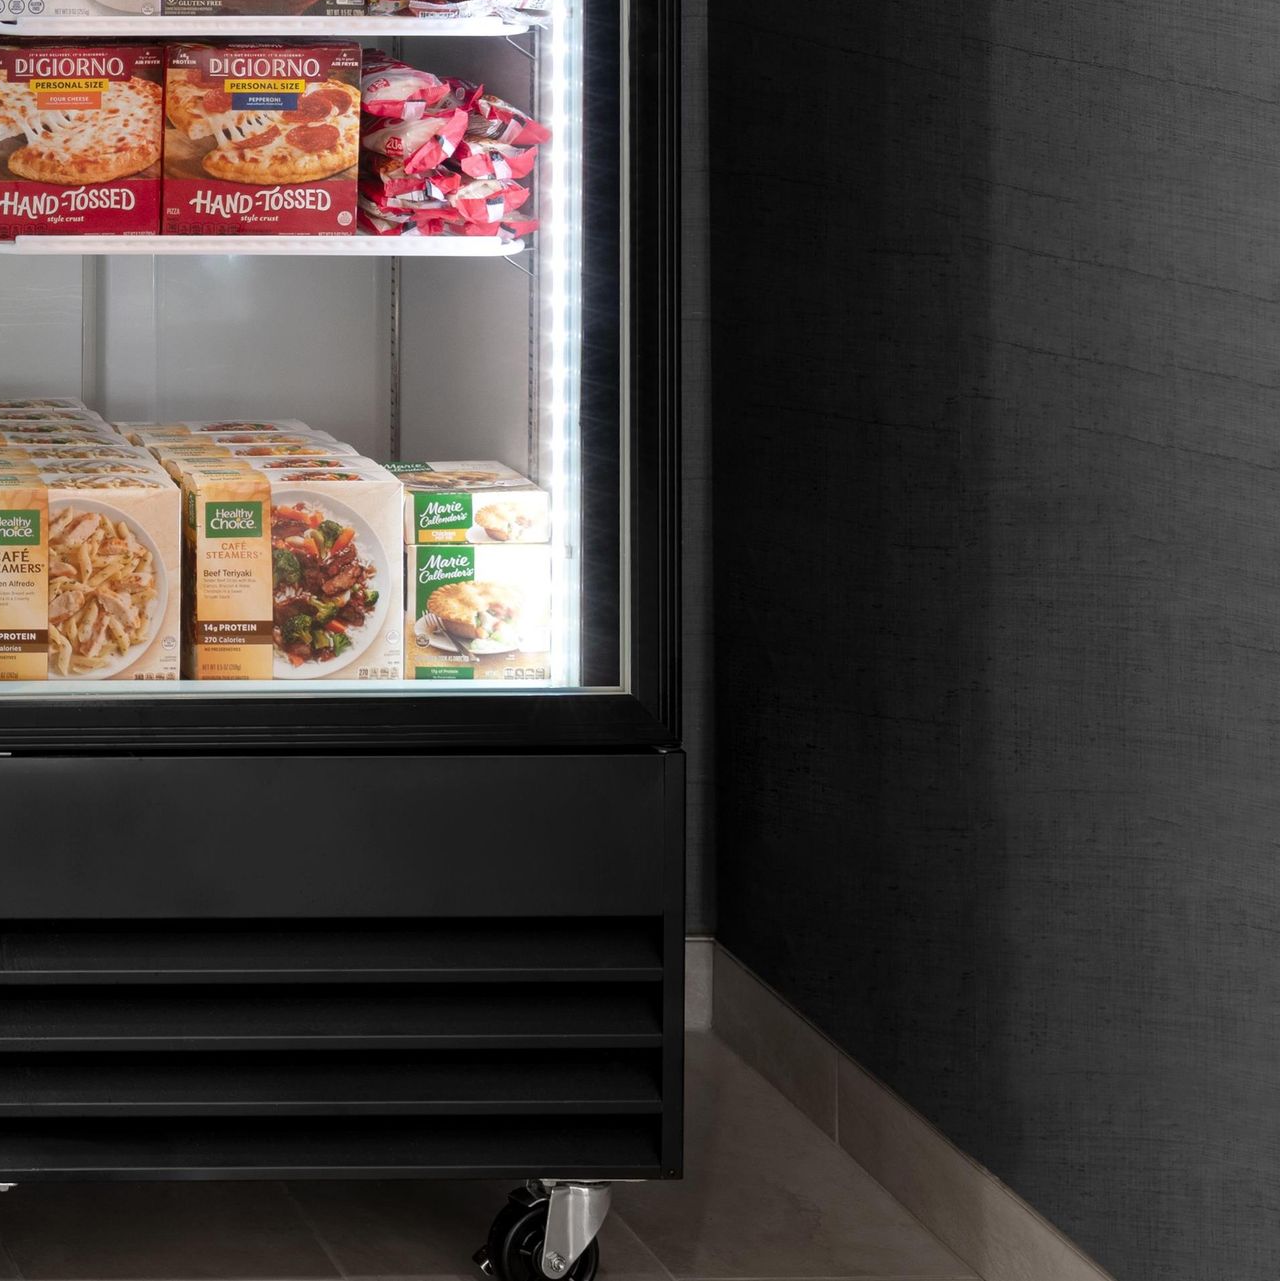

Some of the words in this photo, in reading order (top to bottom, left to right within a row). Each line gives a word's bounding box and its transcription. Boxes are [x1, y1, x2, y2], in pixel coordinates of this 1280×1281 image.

[15, 57, 125, 77] DIGIORNO
[280, 82, 300, 90] SIZE
[189, 186, 331, 218] HAND-TOSSED
[47, 215, 65, 223] style
[420, 554, 470, 572] Marie
[203, 569, 221, 577] Beef
[223, 569, 253, 579] Teriyaki
[8, 580, 35, 588] Alfredo
[204, 623, 218, 632] 14g
